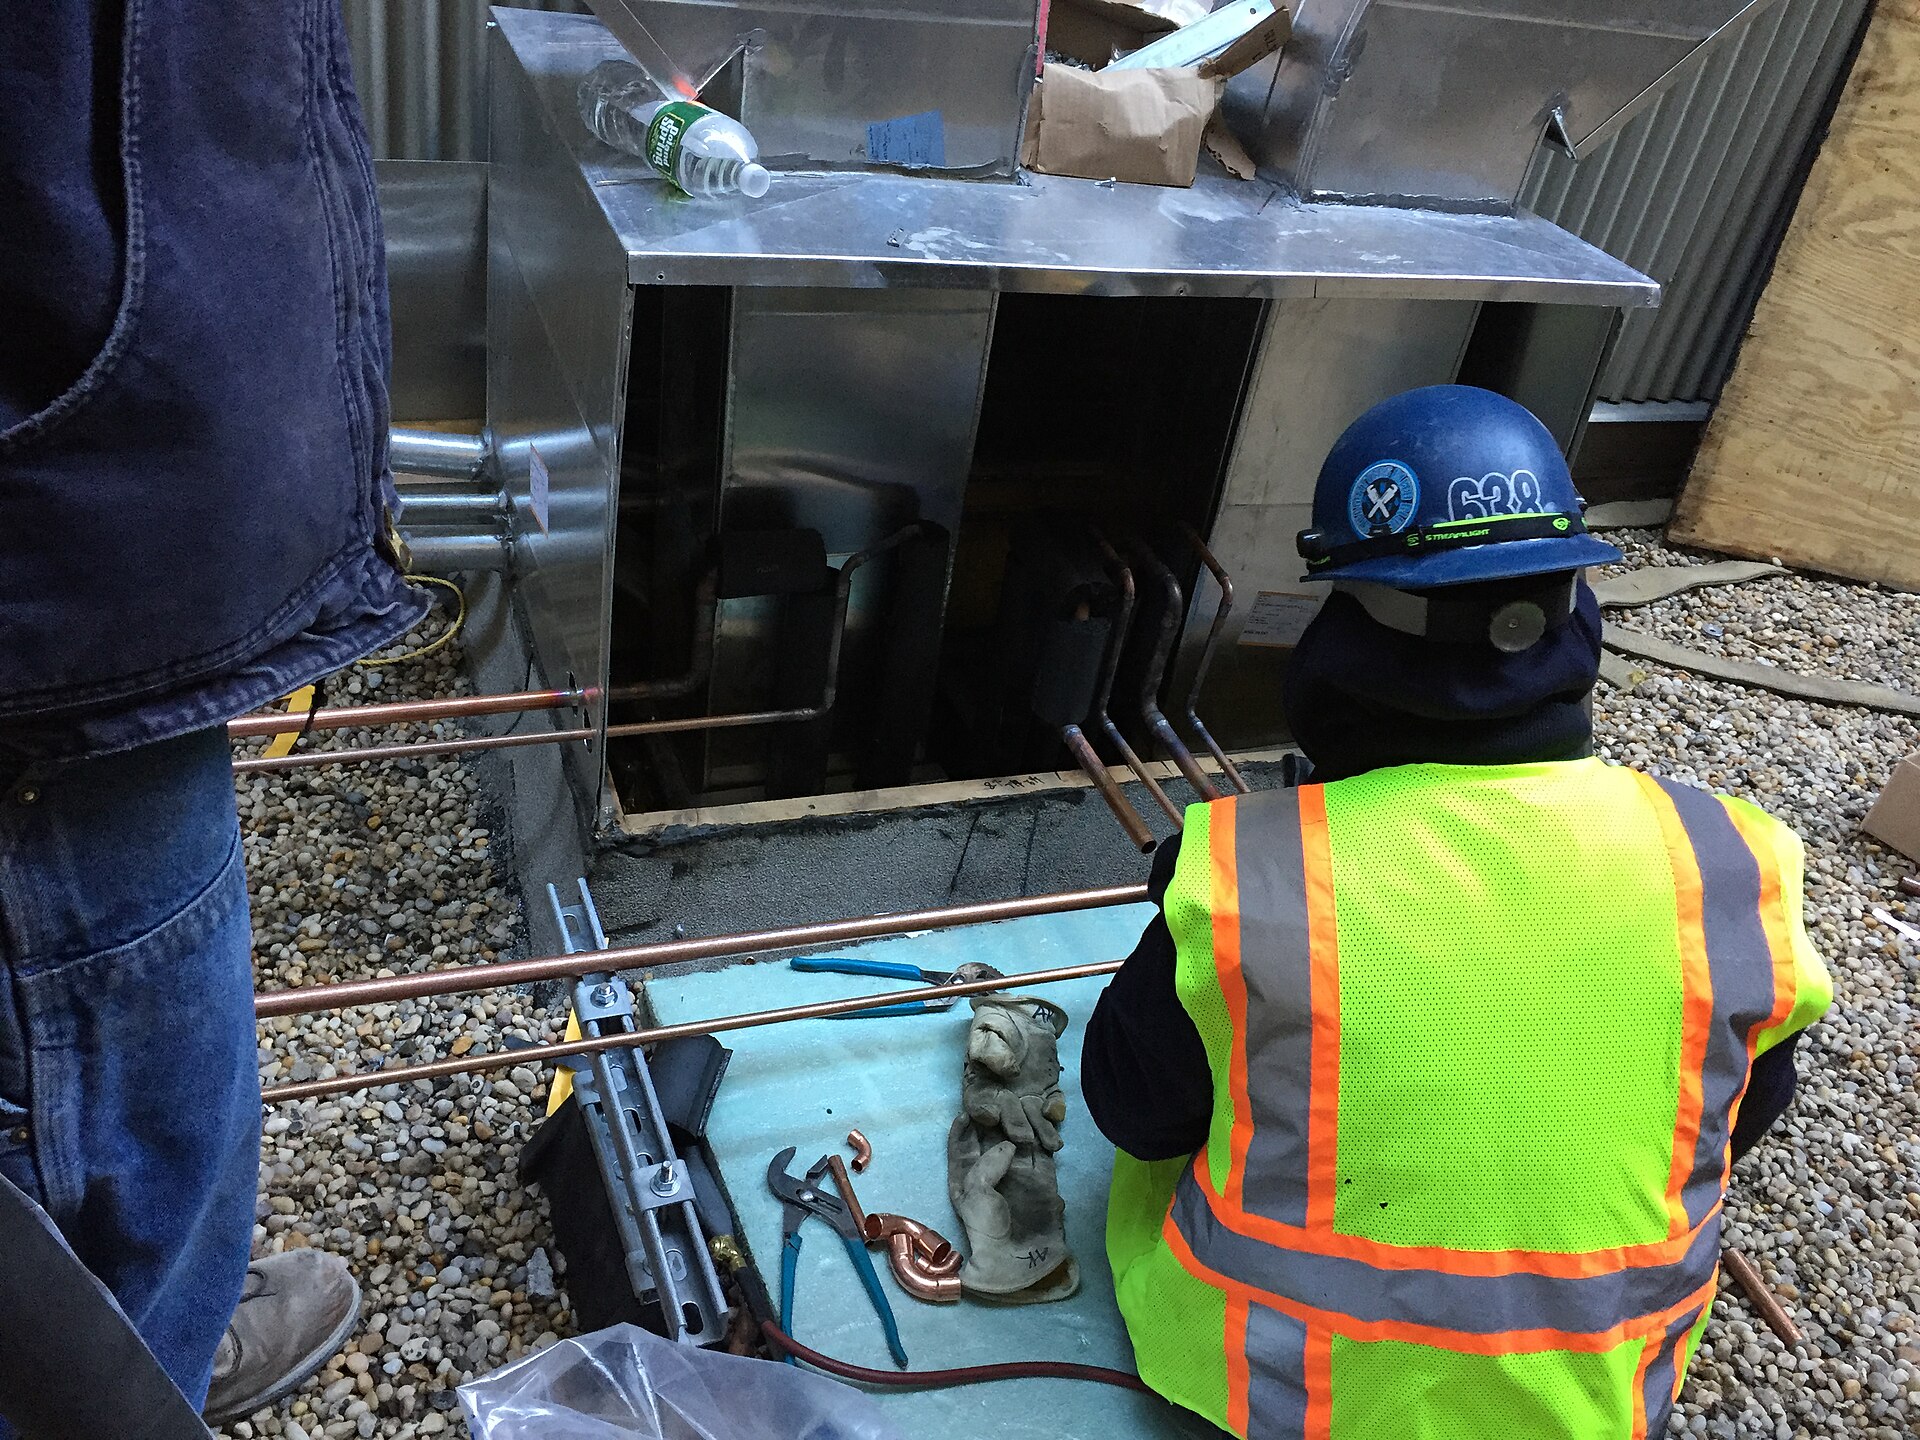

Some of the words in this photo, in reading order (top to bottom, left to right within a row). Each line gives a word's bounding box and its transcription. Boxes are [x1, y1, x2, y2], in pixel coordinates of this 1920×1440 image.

[652, 116, 674, 167] Spring
[662, 125, 680, 168] Poland
[1447, 469, 1545, 522] 638
[1425, 528, 1491, 541] STREAMLIGHT
